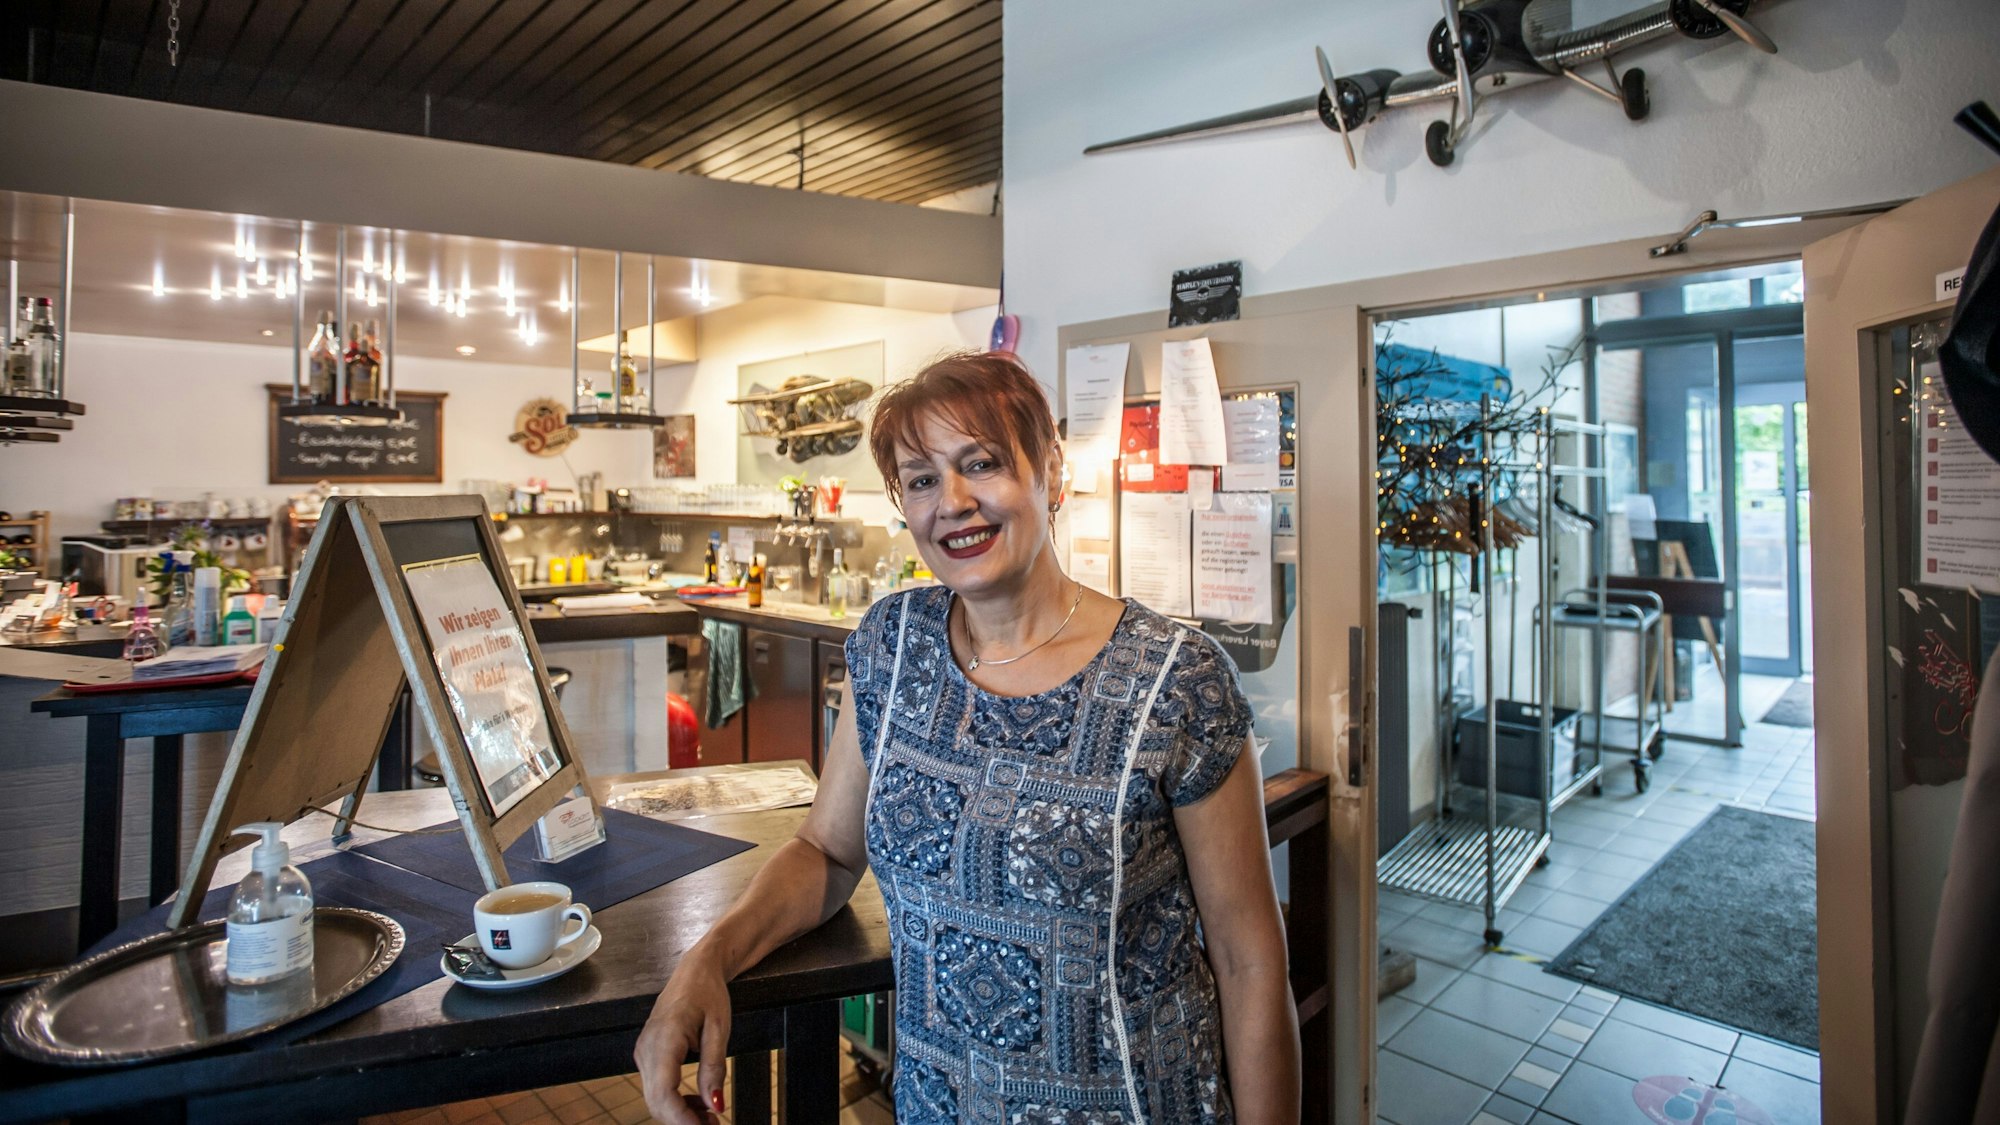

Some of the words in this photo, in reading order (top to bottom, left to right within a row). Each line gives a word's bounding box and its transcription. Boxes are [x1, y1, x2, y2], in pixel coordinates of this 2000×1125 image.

[438, 611, 465, 635] Wir
[464, 606, 502, 629] zeigen
[449, 643, 485, 668] Ihnen
[483, 633, 513, 659] Ihren
